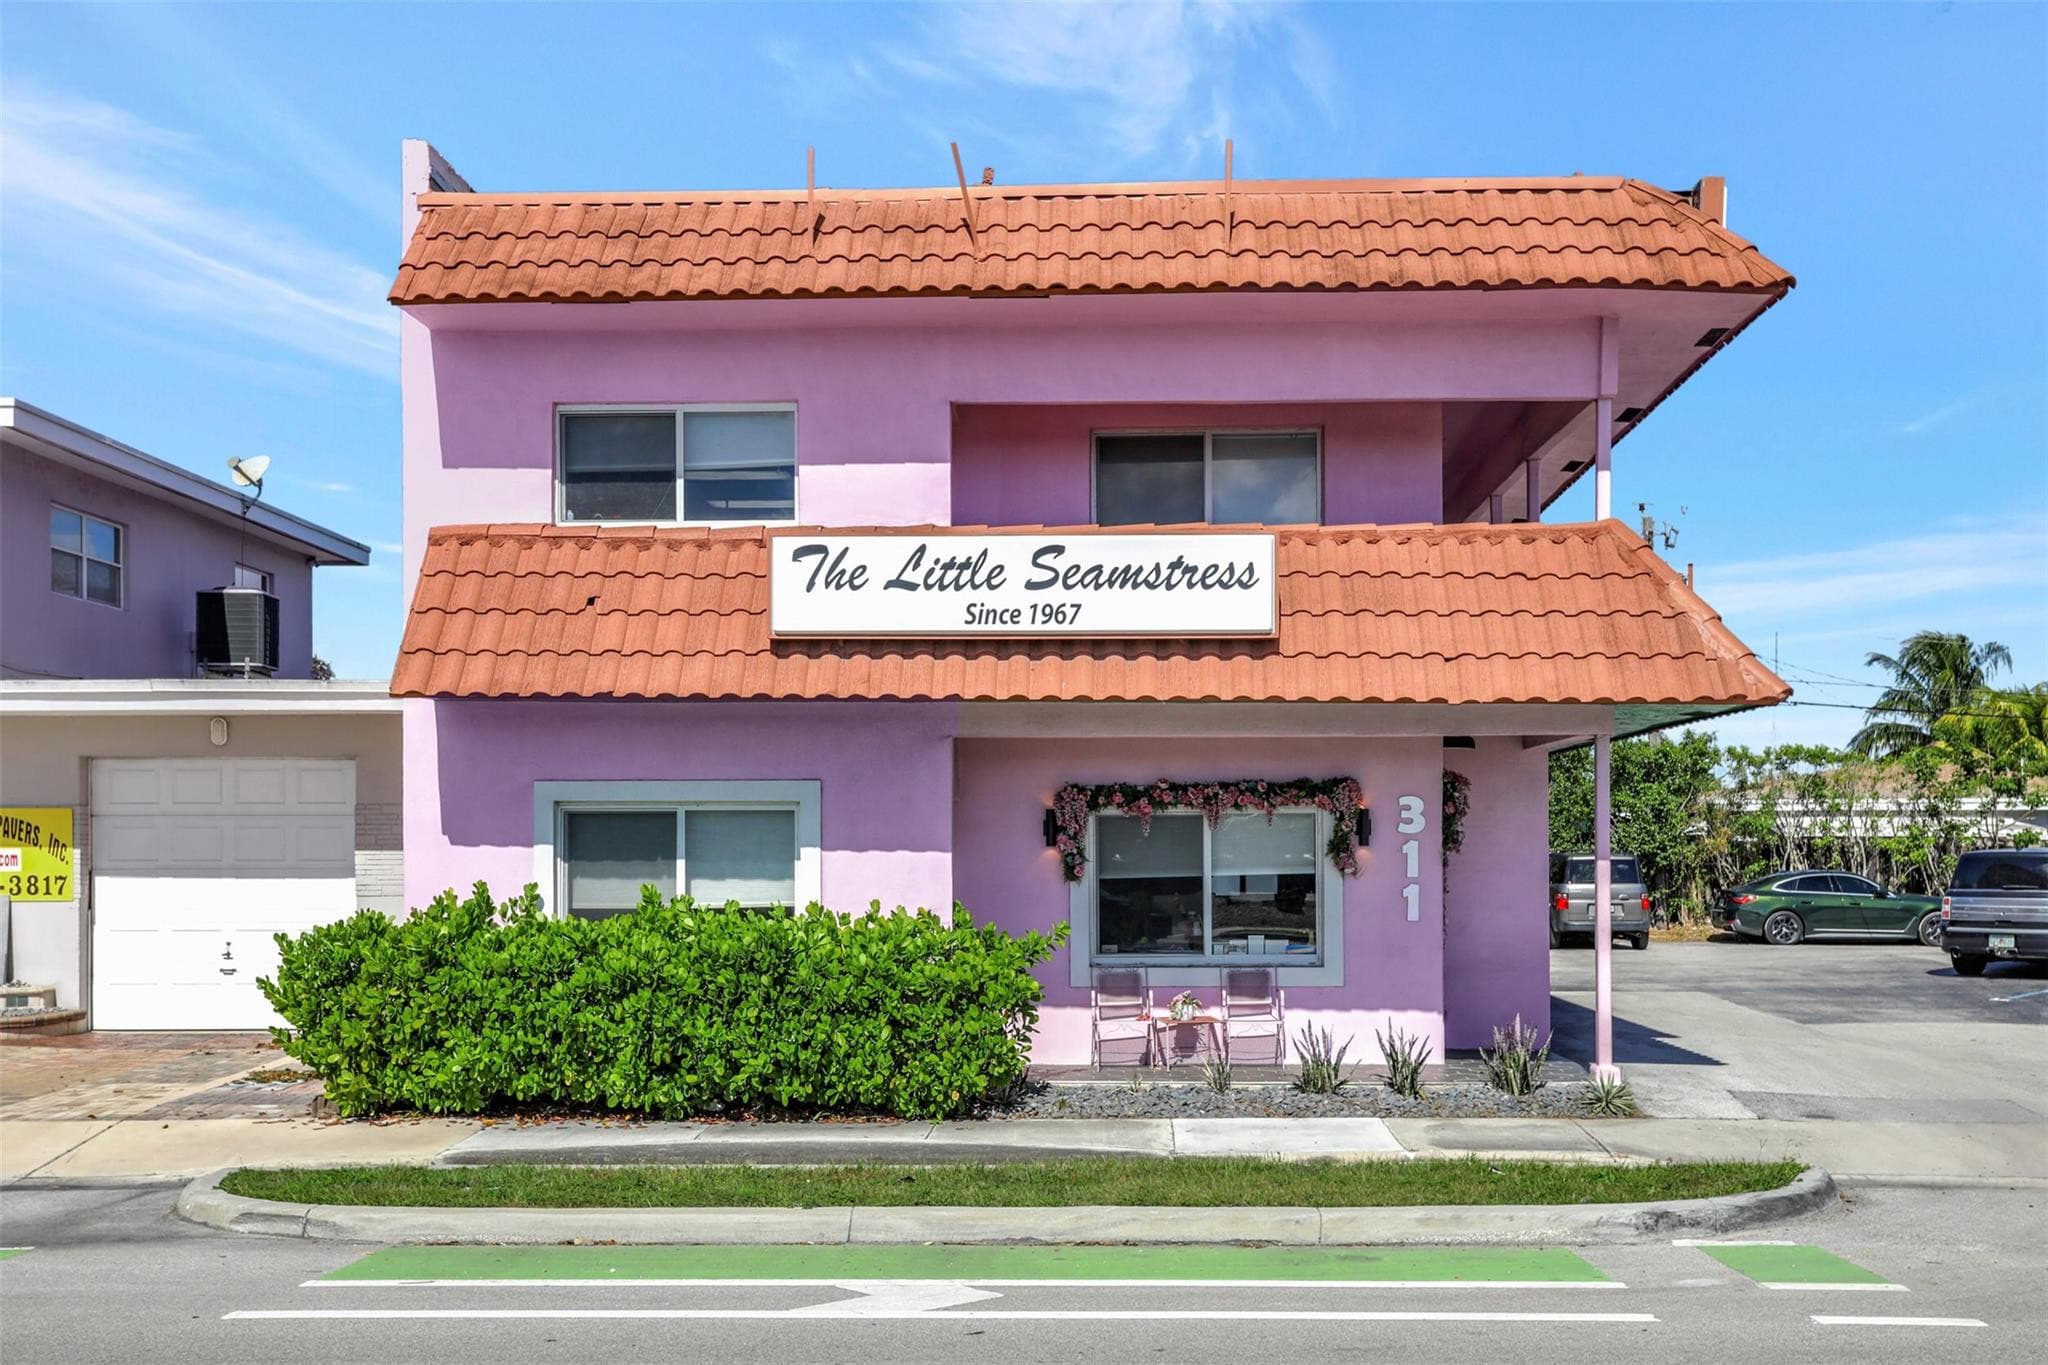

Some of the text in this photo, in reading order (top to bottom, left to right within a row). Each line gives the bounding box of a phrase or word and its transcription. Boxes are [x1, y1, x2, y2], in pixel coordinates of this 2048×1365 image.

[791, 543, 1259, 592] The Little Seamstress
[964, 602, 1082, 625] Since 1967
[1397, 795, 1426, 921] 311
